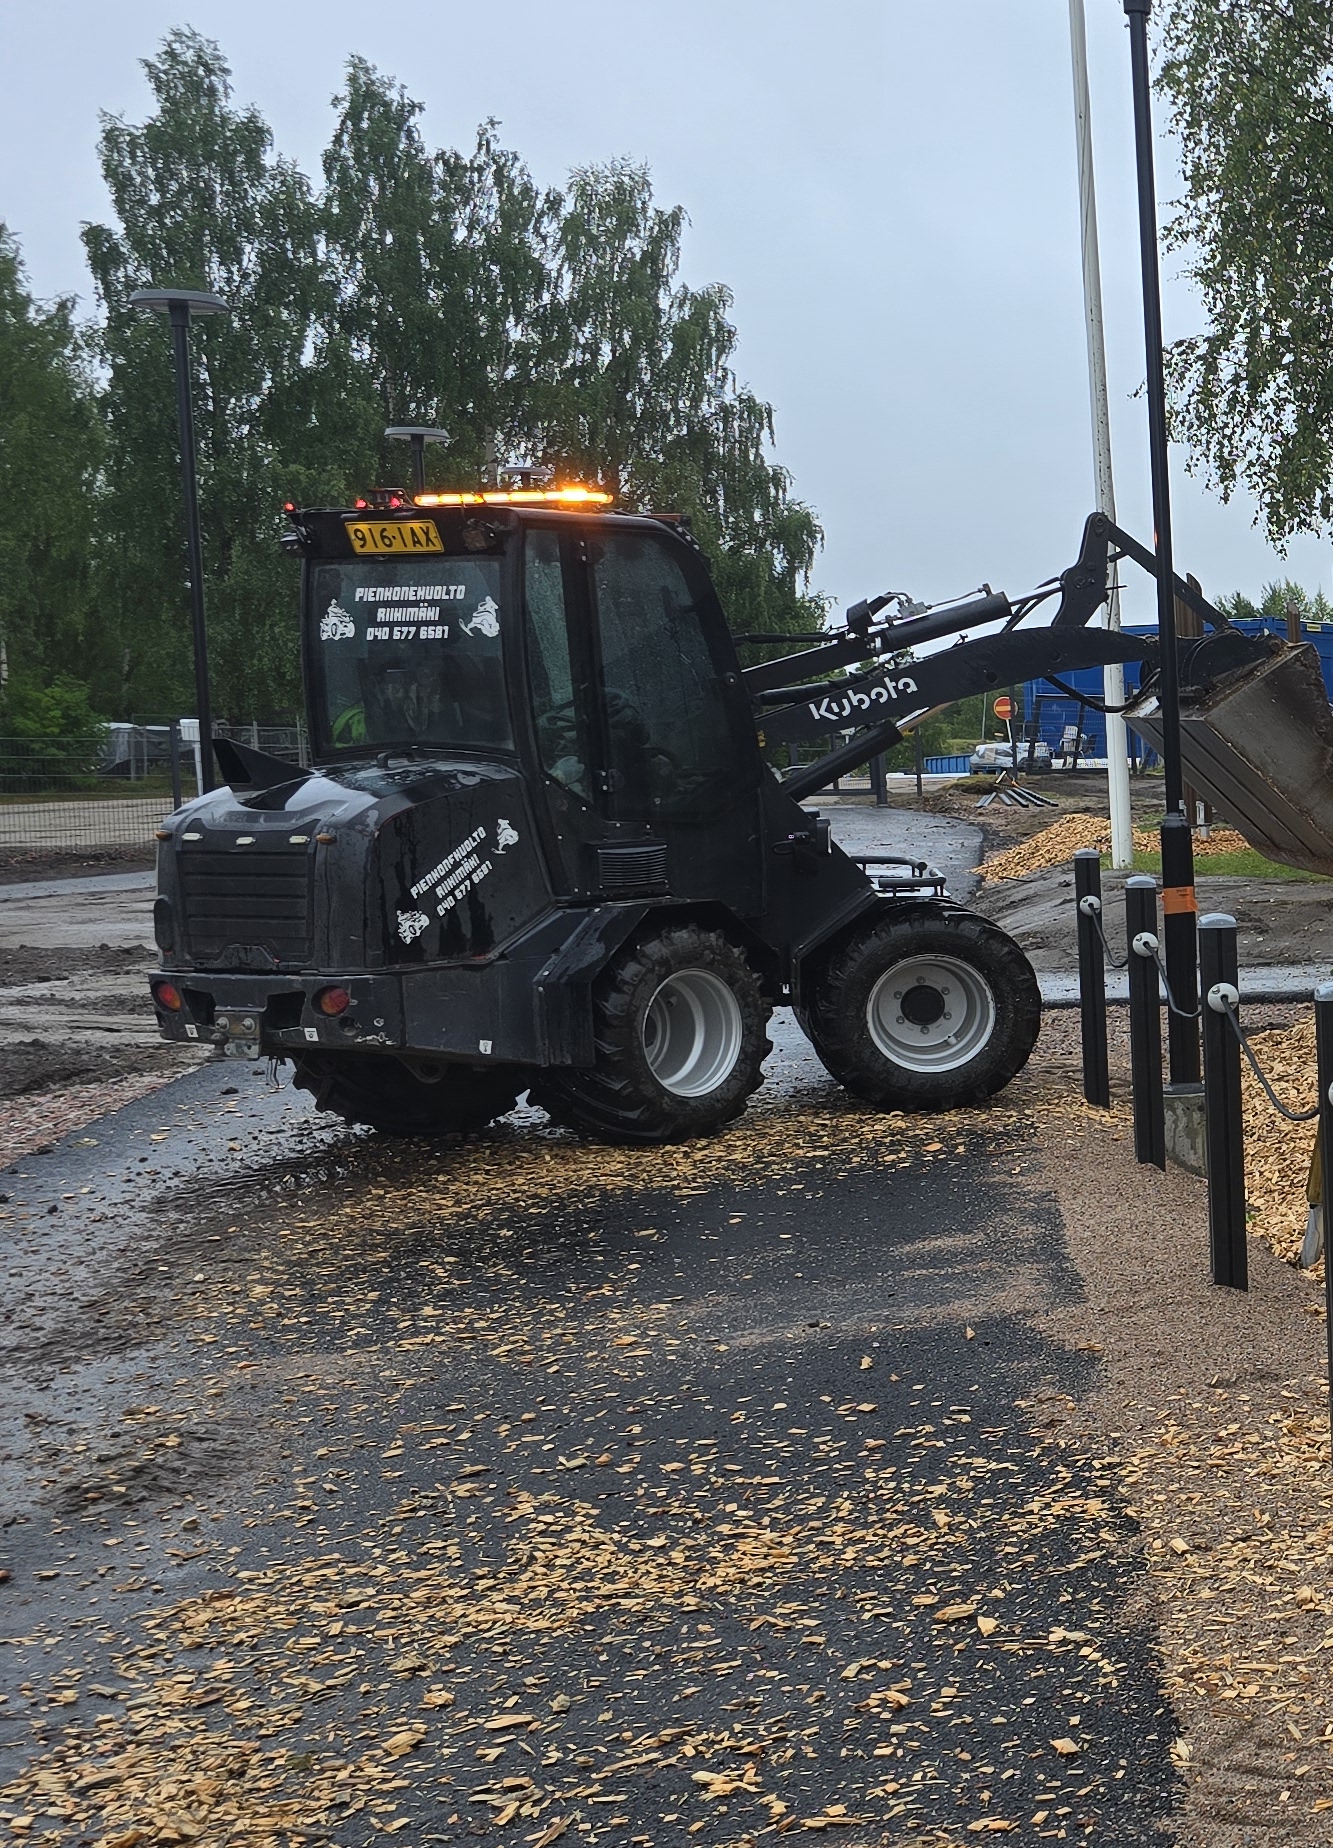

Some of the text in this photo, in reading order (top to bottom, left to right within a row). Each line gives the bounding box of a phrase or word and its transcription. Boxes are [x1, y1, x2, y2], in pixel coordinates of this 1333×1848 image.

[354, 585, 466, 602] PIENKONEHUOLTO
[376, 602, 440, 622] RIIHIMÄKI
[366, 627, 390, 641] 040
[808, 676, 919, 721] Kubota
[436, 895, 456, 917] 040
